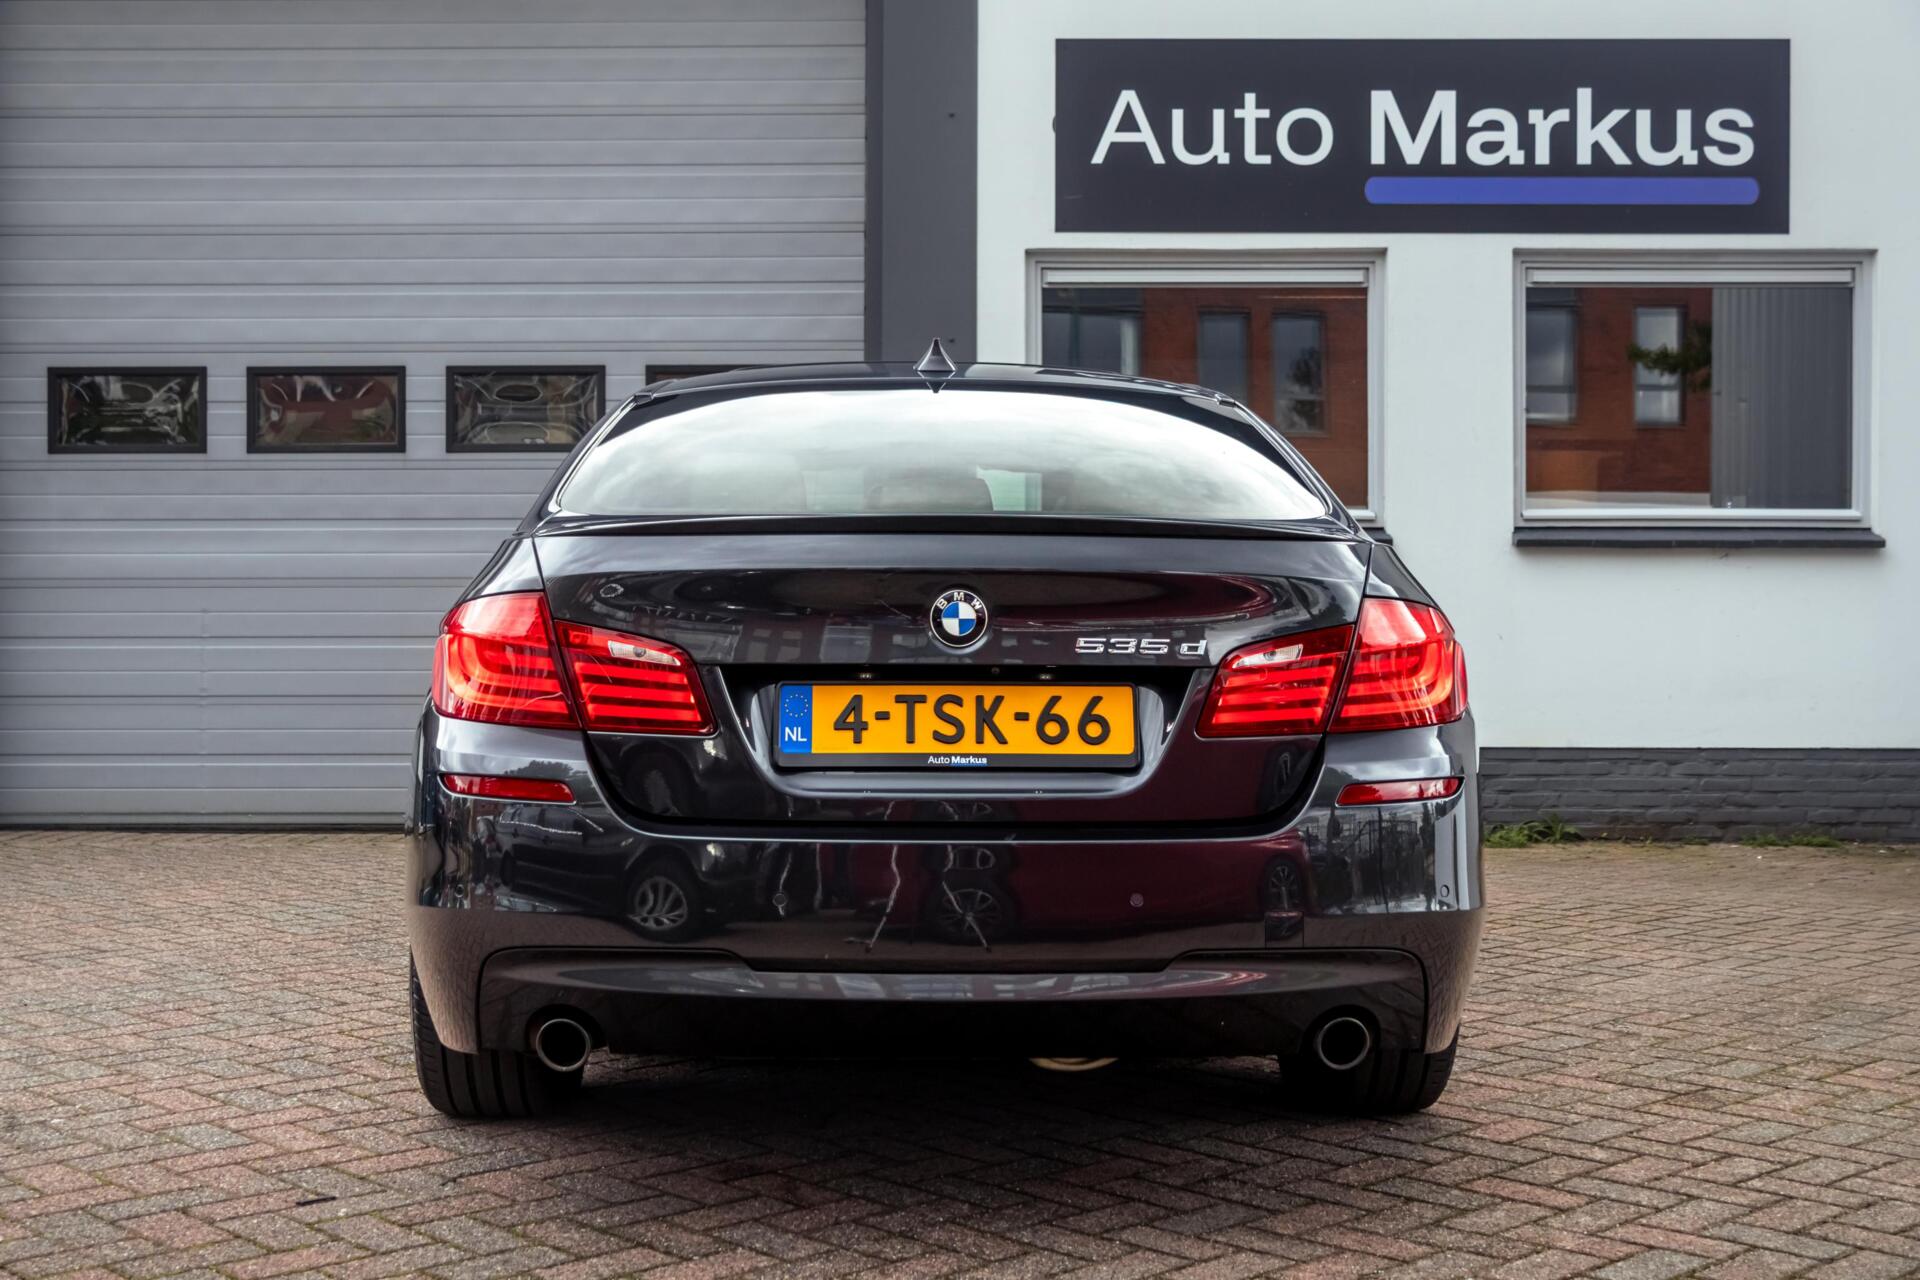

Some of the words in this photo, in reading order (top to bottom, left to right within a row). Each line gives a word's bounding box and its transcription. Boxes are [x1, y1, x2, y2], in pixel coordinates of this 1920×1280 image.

[1090, 89, 1334, 166] Auto
[1370, 87, 1755, 167] Markus
[935, 591, 983, 610] BMW
[833, 694, 1111, 745] 4-TSK-66
[784, 726, 808, 742] NL
[927, 755, 951, 765] Auto
[951, 755, 988, 765] Markus
